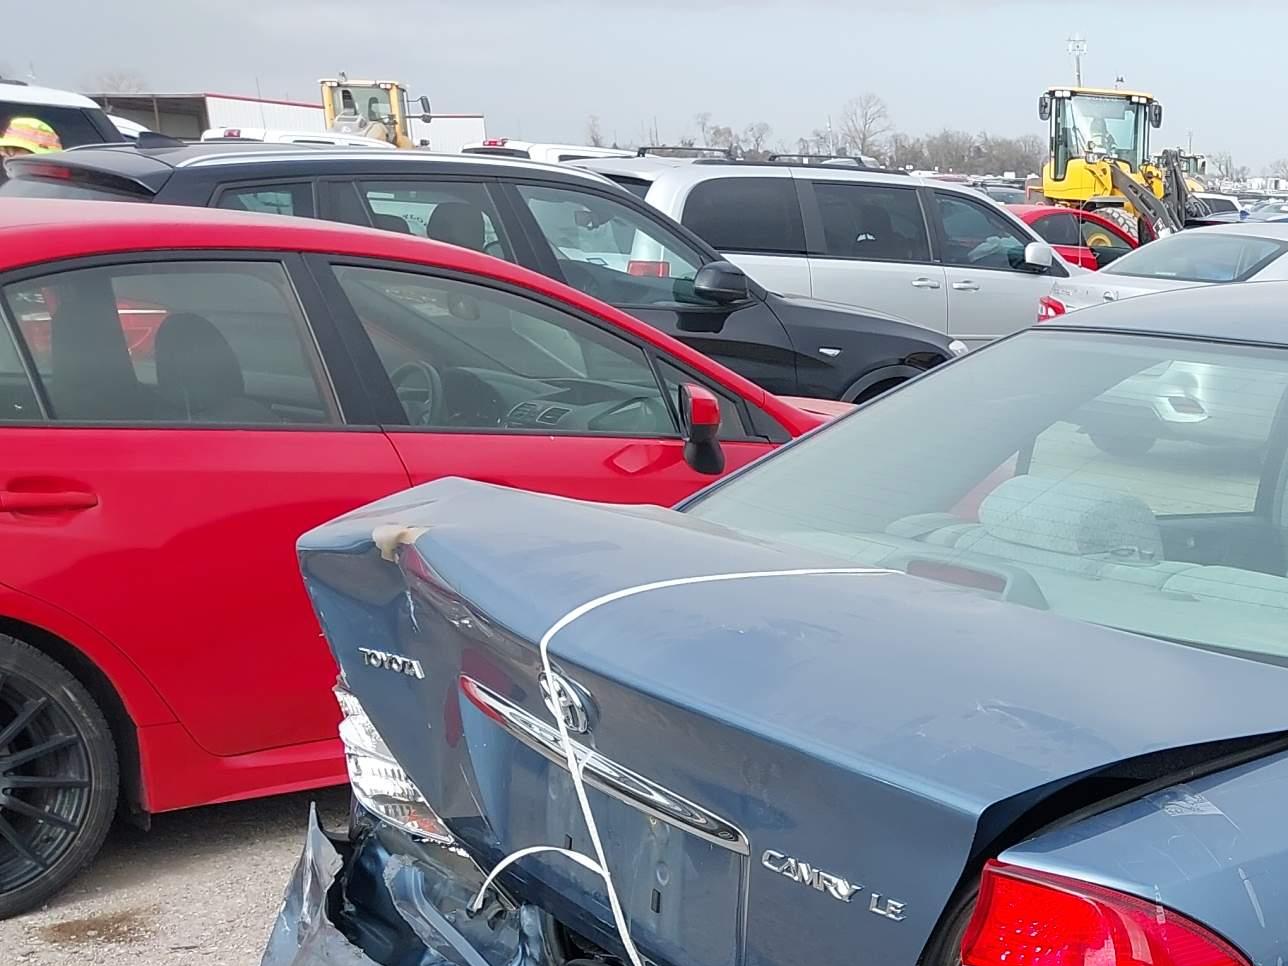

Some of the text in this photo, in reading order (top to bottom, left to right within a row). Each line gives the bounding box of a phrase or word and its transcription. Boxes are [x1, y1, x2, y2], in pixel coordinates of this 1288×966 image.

[358, 647, 425, 680] TOYOTA
[762, 850, 907, 921] CAMRY LE
